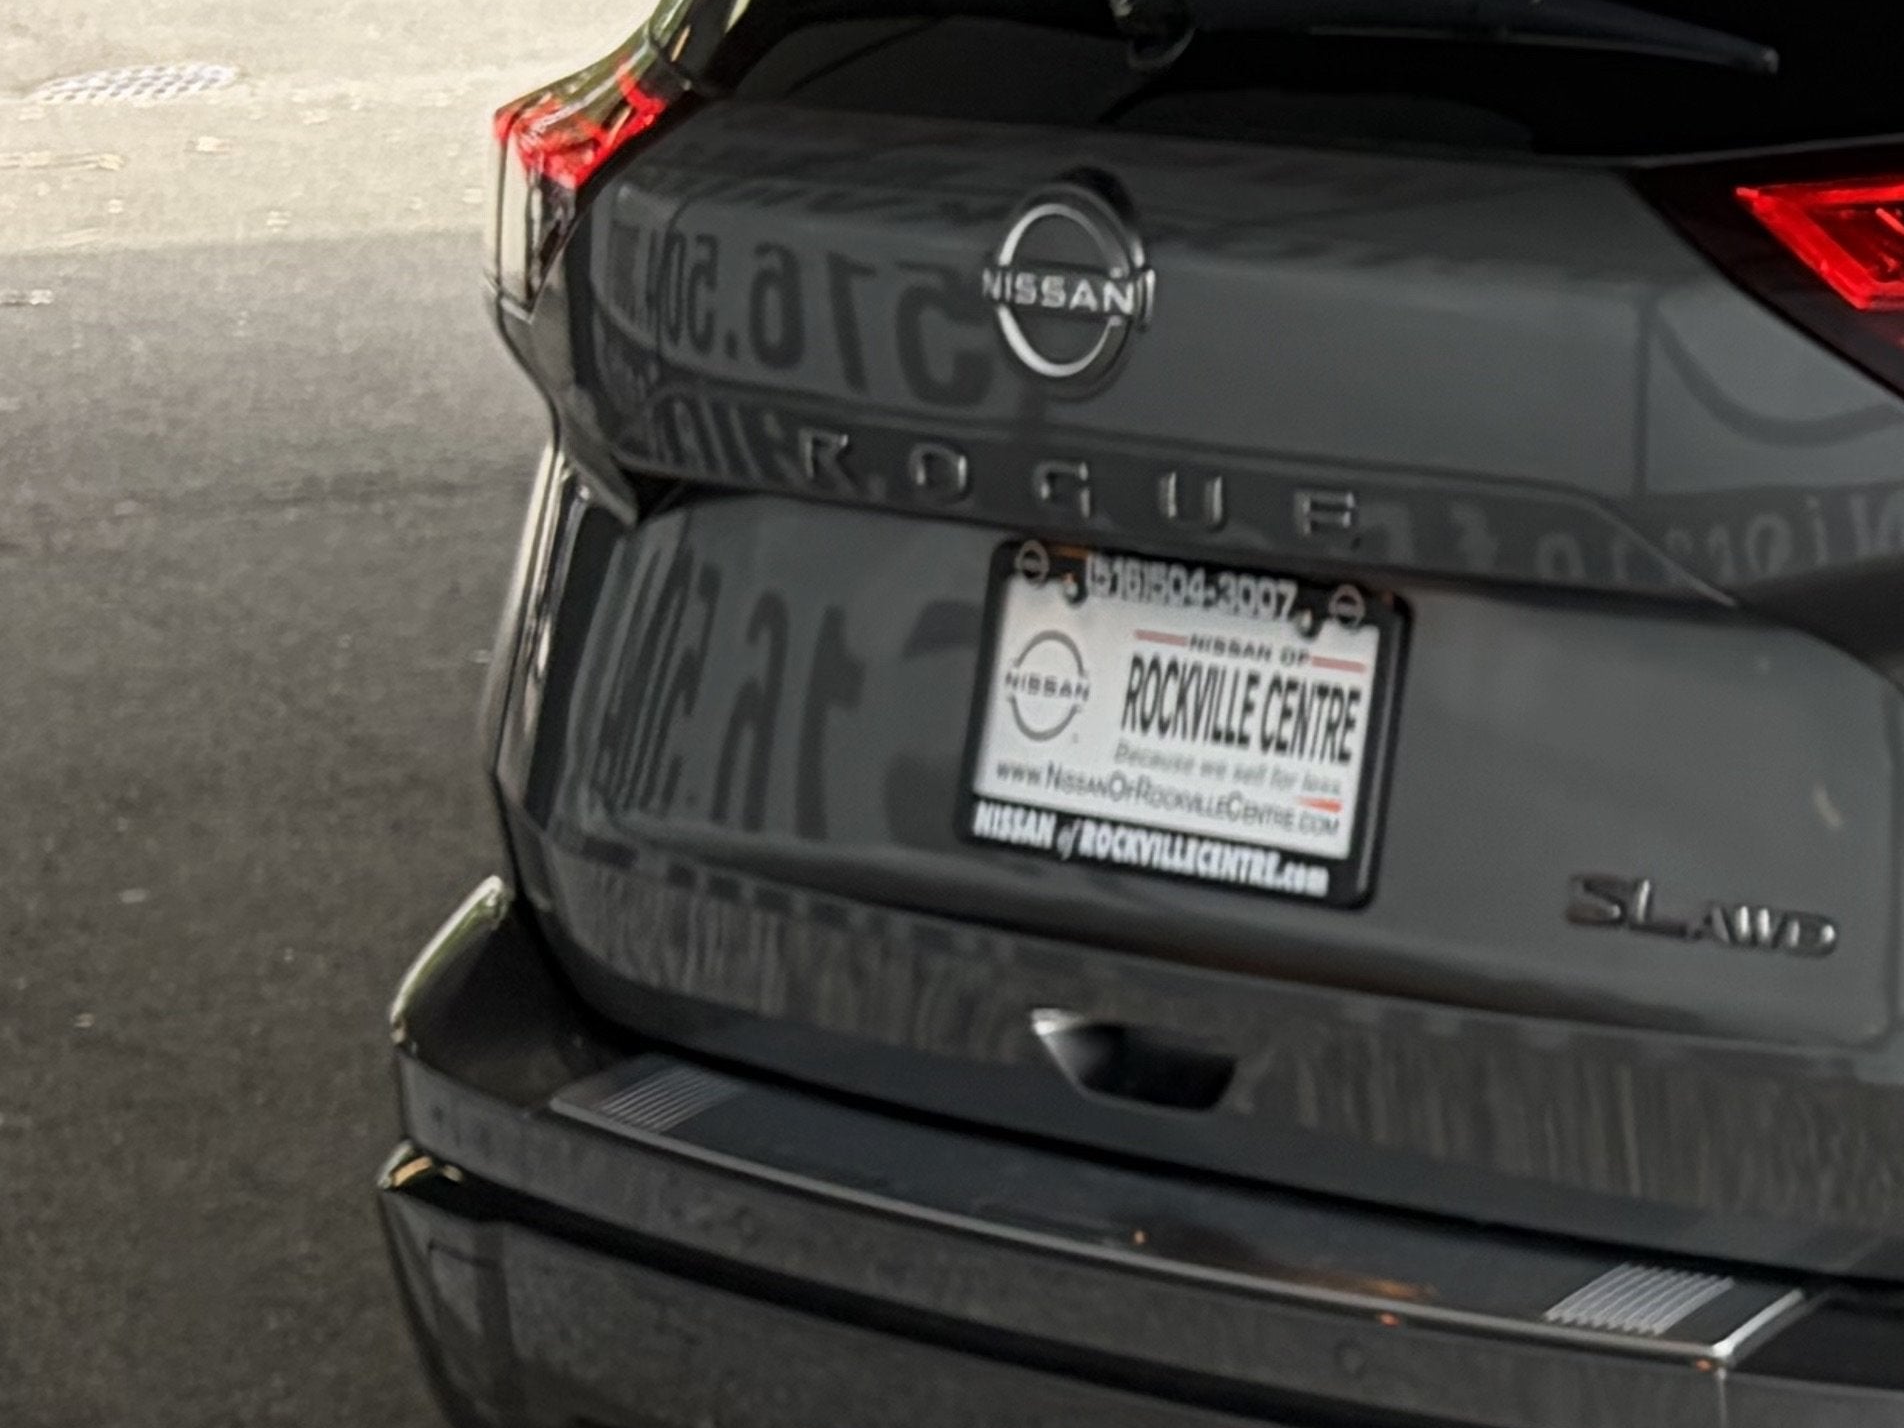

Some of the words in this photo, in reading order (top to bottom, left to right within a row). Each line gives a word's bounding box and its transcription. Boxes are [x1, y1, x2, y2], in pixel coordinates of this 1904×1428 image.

[982, 268, 1136, 316] NISSAN
[799, 427, 1357, 536] ROGUE
[1190, 633, 1273, 663] NISSAN
[1279, 645, 1311, 668] OF
[1004, 670, 1091, 703] NISSAN
[1121, 652, 1261, 747] ROCKVILLE
[1260, 672, 1362, 765] CENTRE
[973, 801, 1058, 850] NISSAN
[1564, 874, 1702, 941] SL
[1703, 902, 1839, 960] AWD
